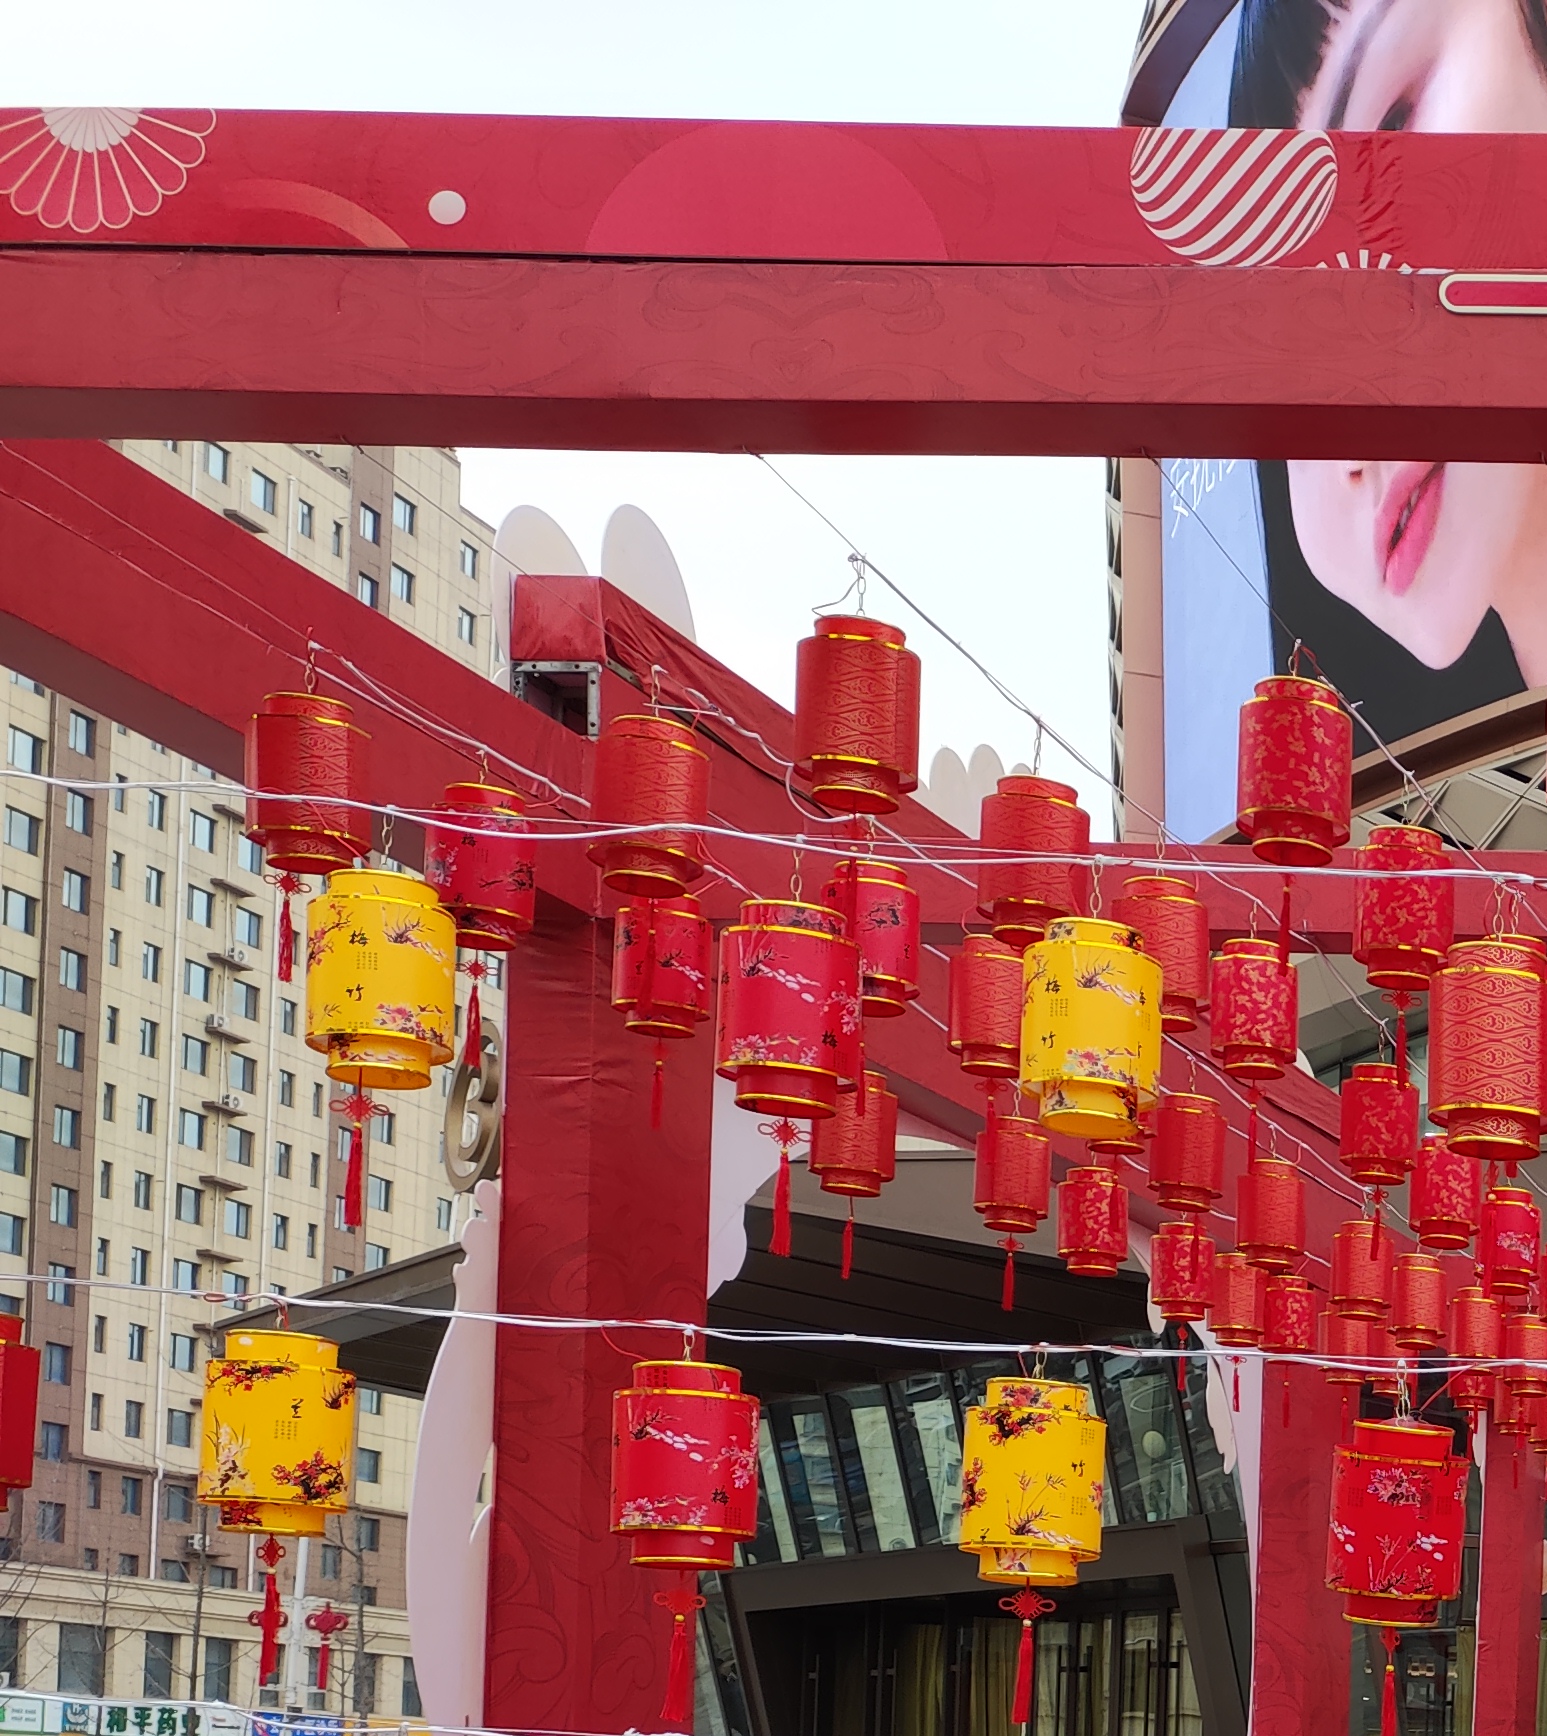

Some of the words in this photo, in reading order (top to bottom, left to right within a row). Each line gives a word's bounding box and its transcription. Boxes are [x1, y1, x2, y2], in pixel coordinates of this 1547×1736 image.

[349, 927, 368, 946] 梅
[346, 984, 364, 1001] 竹
[1045, 976, 1061, 995] 梅
[822, 1029, 838, 1049] 梅
[1041, 1031, 1055, 1048] 竹
[1071, 1460, 1085, 1477] 竹
[711, 1486, 729, 1505] 梅
